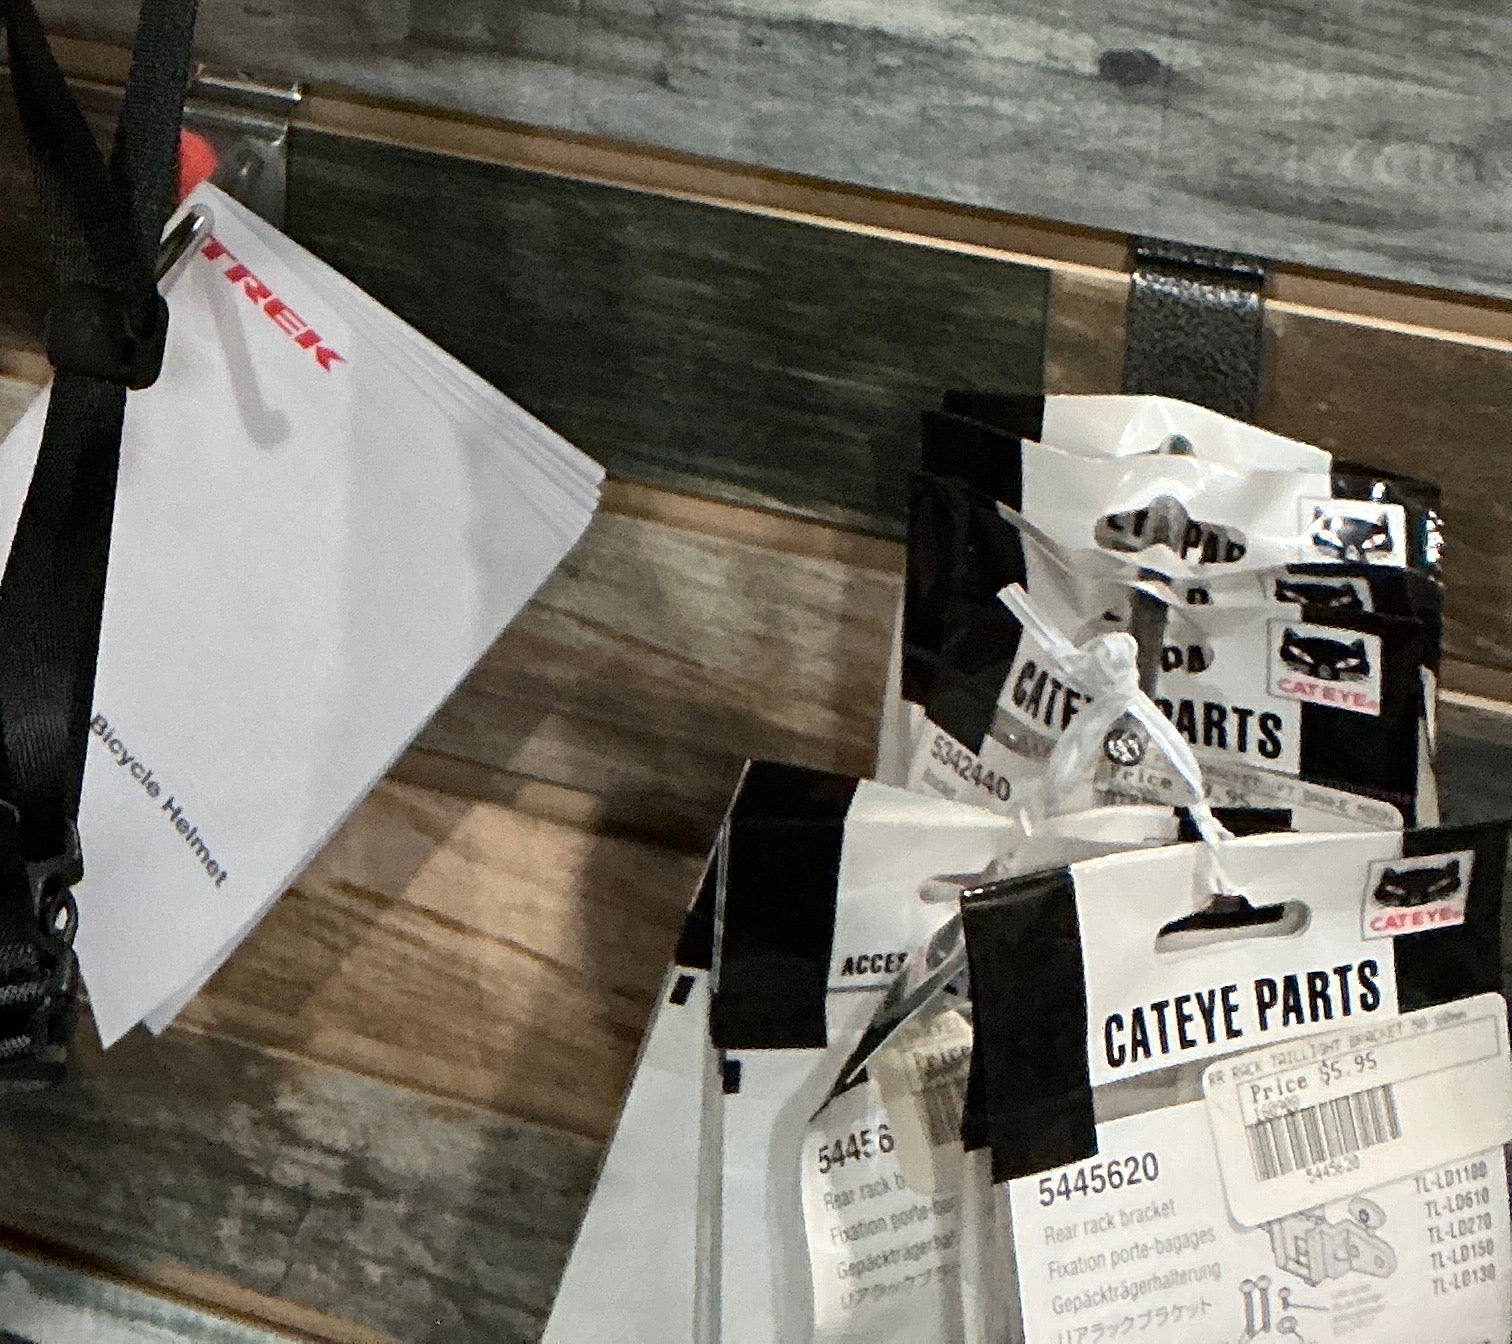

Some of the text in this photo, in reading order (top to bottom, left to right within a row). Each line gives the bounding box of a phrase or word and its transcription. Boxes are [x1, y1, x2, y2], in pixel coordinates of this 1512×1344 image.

[201, 232, 346, 373] TREK
[1277, 676, 1372, 709] CATEYE
[90, 714, 228, 889] Bicycle Helmet
[1370, 908, 1455, 932] CATEYE
[1103, 958, 1382, 1068] CATEYE PARTS
[1250, 1052, 1378, 1104] Price $5.95
[1038, 1151, 1160, 1208] 5445620
[1043, 1198, 1178, 1247] Rear rack bracket
[1047, 1225, 1218, 1282] Fixation porte-bagages
